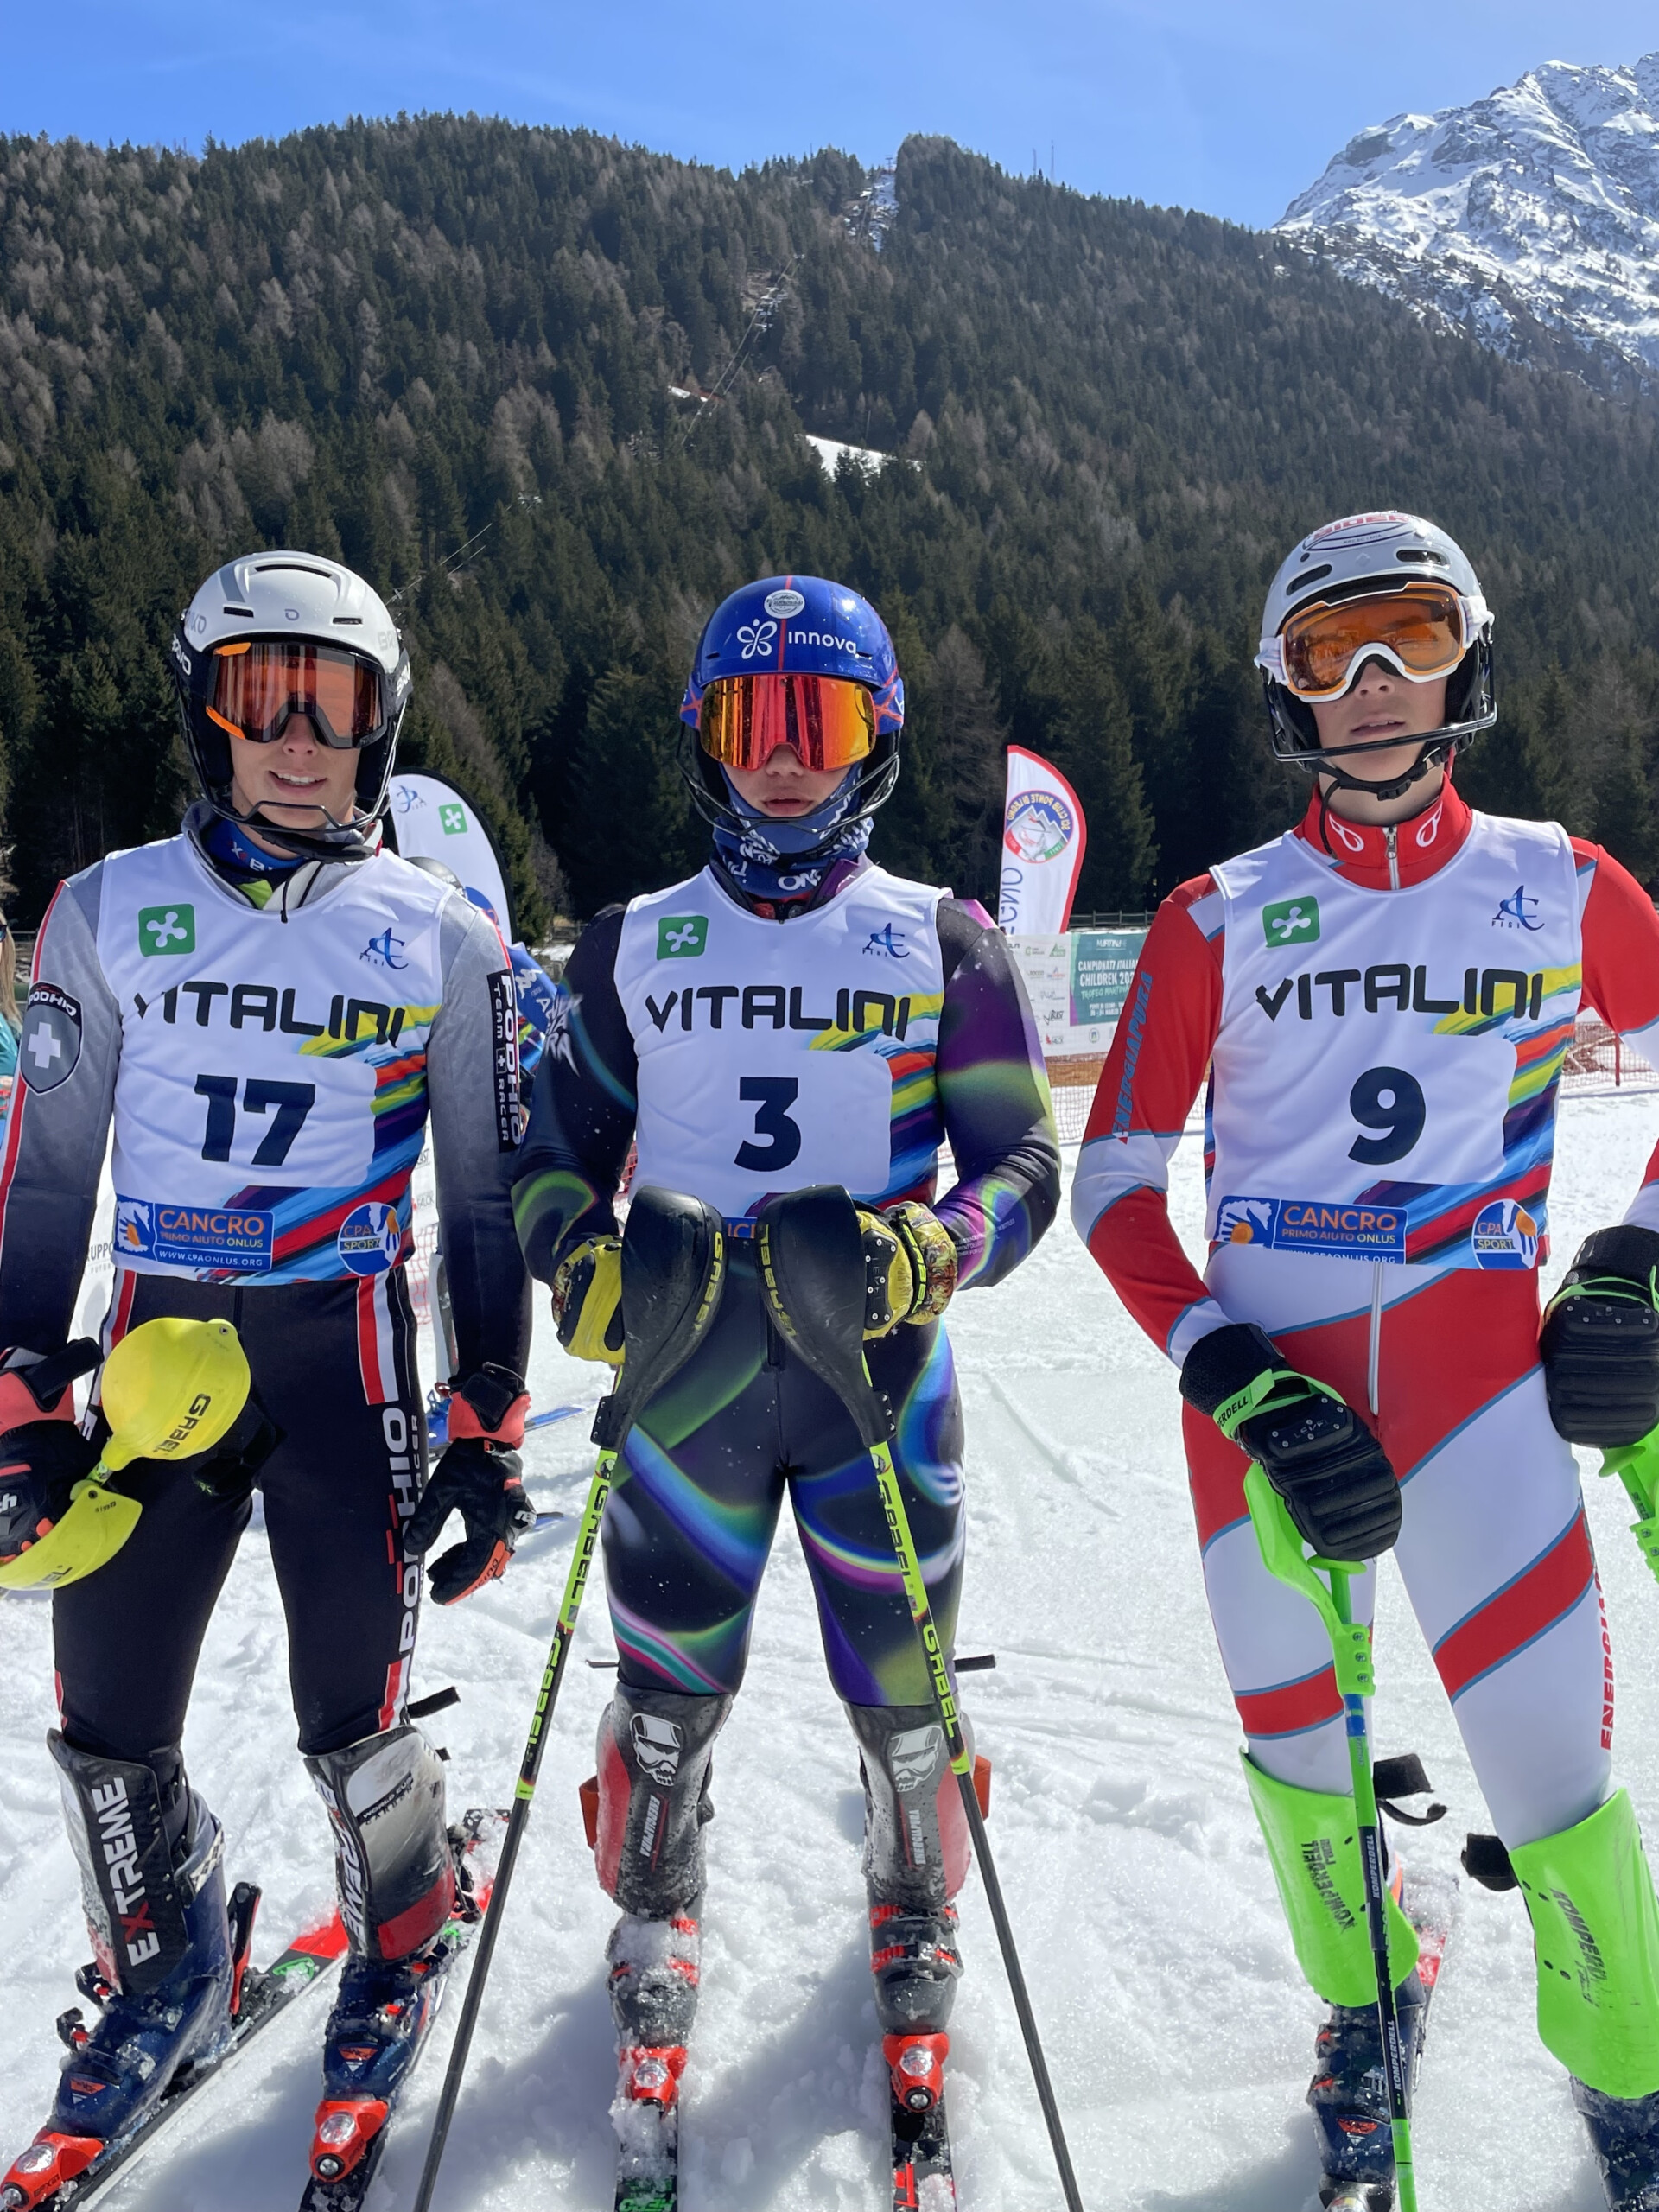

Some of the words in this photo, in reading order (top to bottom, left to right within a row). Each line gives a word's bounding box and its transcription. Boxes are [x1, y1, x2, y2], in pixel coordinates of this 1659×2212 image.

[788, 631, 857, 656] innova
[1078, 960, 1116, 972] CAMPIONATI
[1080, 972, 1117, 987] CHILDREN
[1119, 971, 1135, 986] 202
[1255, 963, 1544, 1022] VITALINI
[493, 982, 505, 1039] TEAM
[645, 986, 911, 1042] VITALINI
[501, 975, 524, 1146] PODHIO
[194, 1074, 316, 1166] 17
[498, 1078, 510, 1141] RACER
[734, 1077, 802, 1173] 3
[1347, 1066, 1427, 1165] 9
[159, 1210, 264, 1236] CANCRO
[226, 1236, 264, 1248] ONLUS
[344, 1224, 372, 1237] CPA
[344, 1238, 380, 1251] SPORT
[1281, 1229, 1319, 1240] PRIMO
[1319, 1231, 1355, 1243] AIUTO
[1357, 1233, 1396, 1244] ONLUS
[1283, 1205, 1398, 1232] CANCRO
[1478, 1221, 1503, 1236] CPA
[1478, 1238, 1514, 1250] SPORT
[159, 1250, 264, 1266] WWW.CPAONLUS.ORG
[154, 1393, 211, 1454] GABEL
[382, 1408, 420, 1654] POHIO
[572, 1484, 609, 1599] GABEL
[922, 1624, 956, 1738] GABEL
[91, 1777, 162, 1967] EXTREME
[1365, 1834, 1381, 1899] KOMPERDELL
[1388, 2020, 1402, 2091] KOMPERDELL
